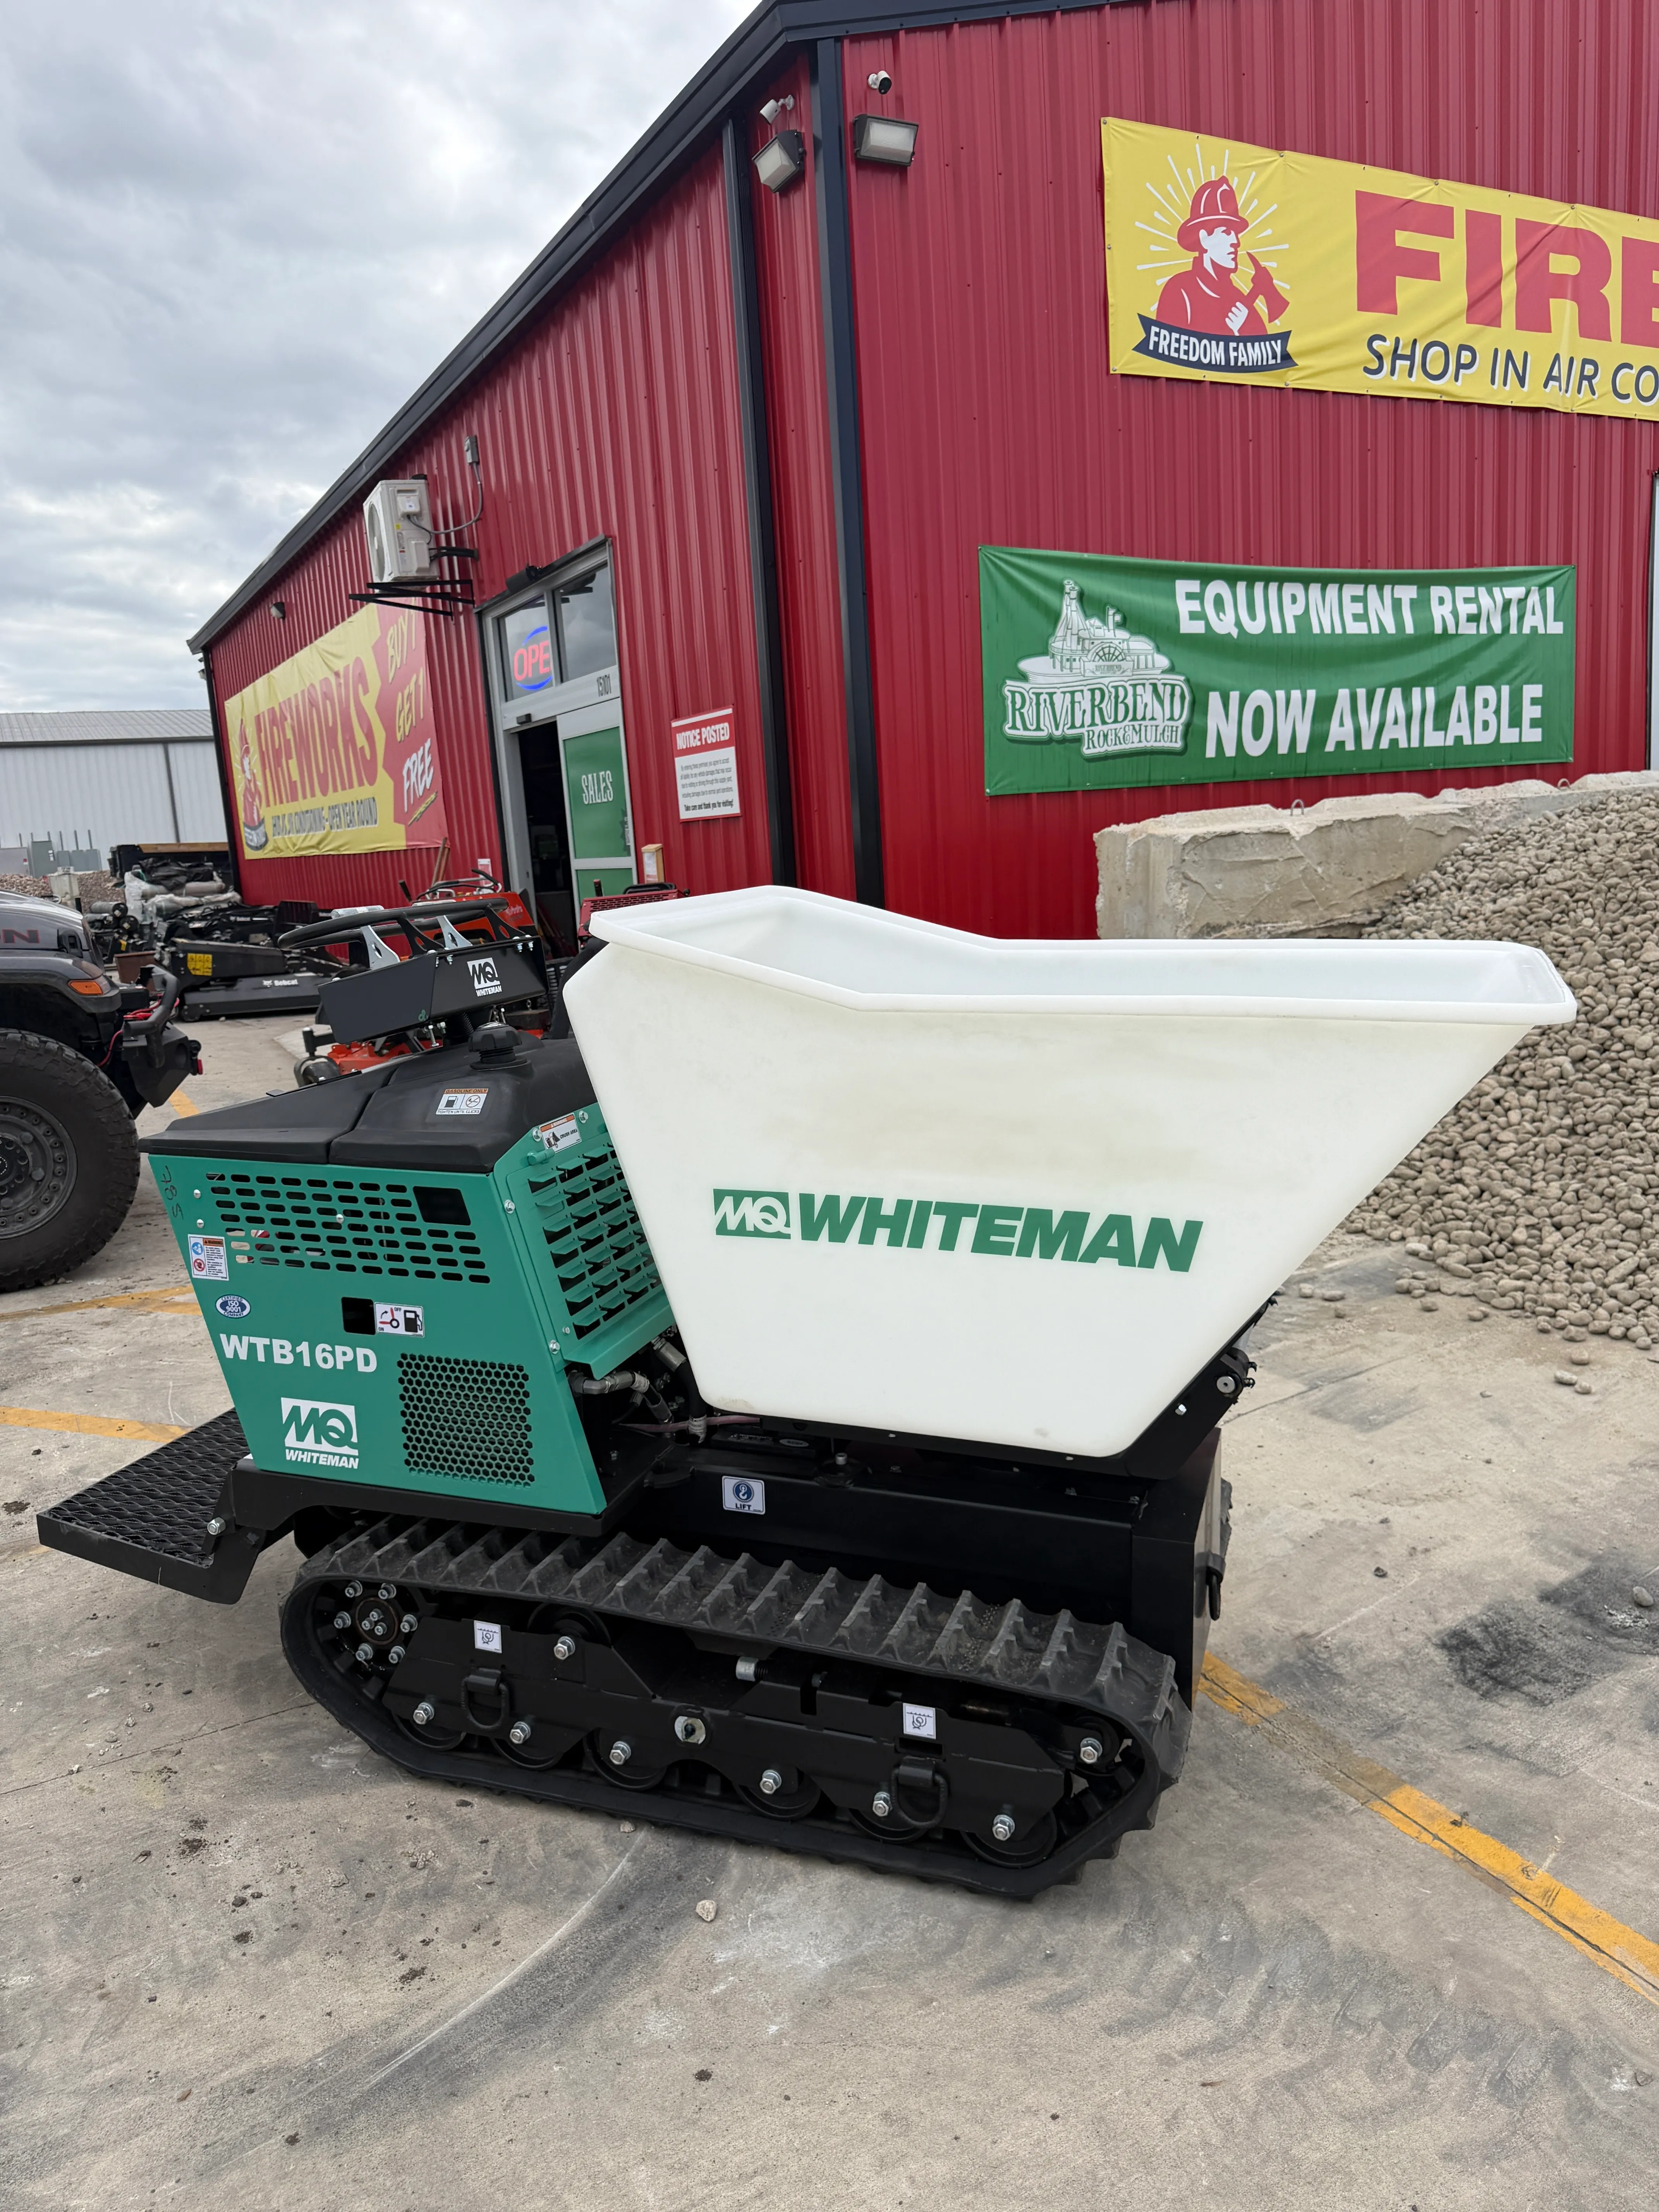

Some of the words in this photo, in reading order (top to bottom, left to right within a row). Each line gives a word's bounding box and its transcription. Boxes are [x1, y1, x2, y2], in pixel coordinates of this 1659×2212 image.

[1149, 326, 1225, 365] FREEDOM
[1229, 340, 1281, 366] FAMILY
[1363, 334, 1478, 385] SHOP
[1491, 348, 1530, 391] IN
[1543, 353, 1600, 398] AIR
[1611, 362, 1659, 405] CO
[1175, 579, 1417, 639] EQUIPMENT
[1430, 586, 1563, 634] RENTAL
[386, 607, 409, 684] BUY
[514, 640, 553, 681] OPE
[395, 673, 416, 742] GET
[419, 667, 424, 720] 1
[1008, 682, 1186, 733] RIVERBEND
[1206, 689, 1316, 758] NOW
[1324, 684, 1542, 752] AVAILABLE
[254, 656, 378, 808] FIREWORKS
[676, 729, 701, 750] NOTICE
[701, 722, 730, 745] POSTED
[403, 738, 434, 812] FREE
[581, 770, 613, 804] SALES
[0, 928, 40, 944] N
[469, 960, 500, 986] MQ
[476, 985, 502, 997] WHITEMAN
[714, 1192, 790, 1237] MQ
[799, 1193, 1203, 1272] WHITEMAN
[220, 1333, 377, 1372] WTB16PD
[282, 1402, 358, 1451] MQ
[285, 1449, 359, 1469] WHITEMAN
